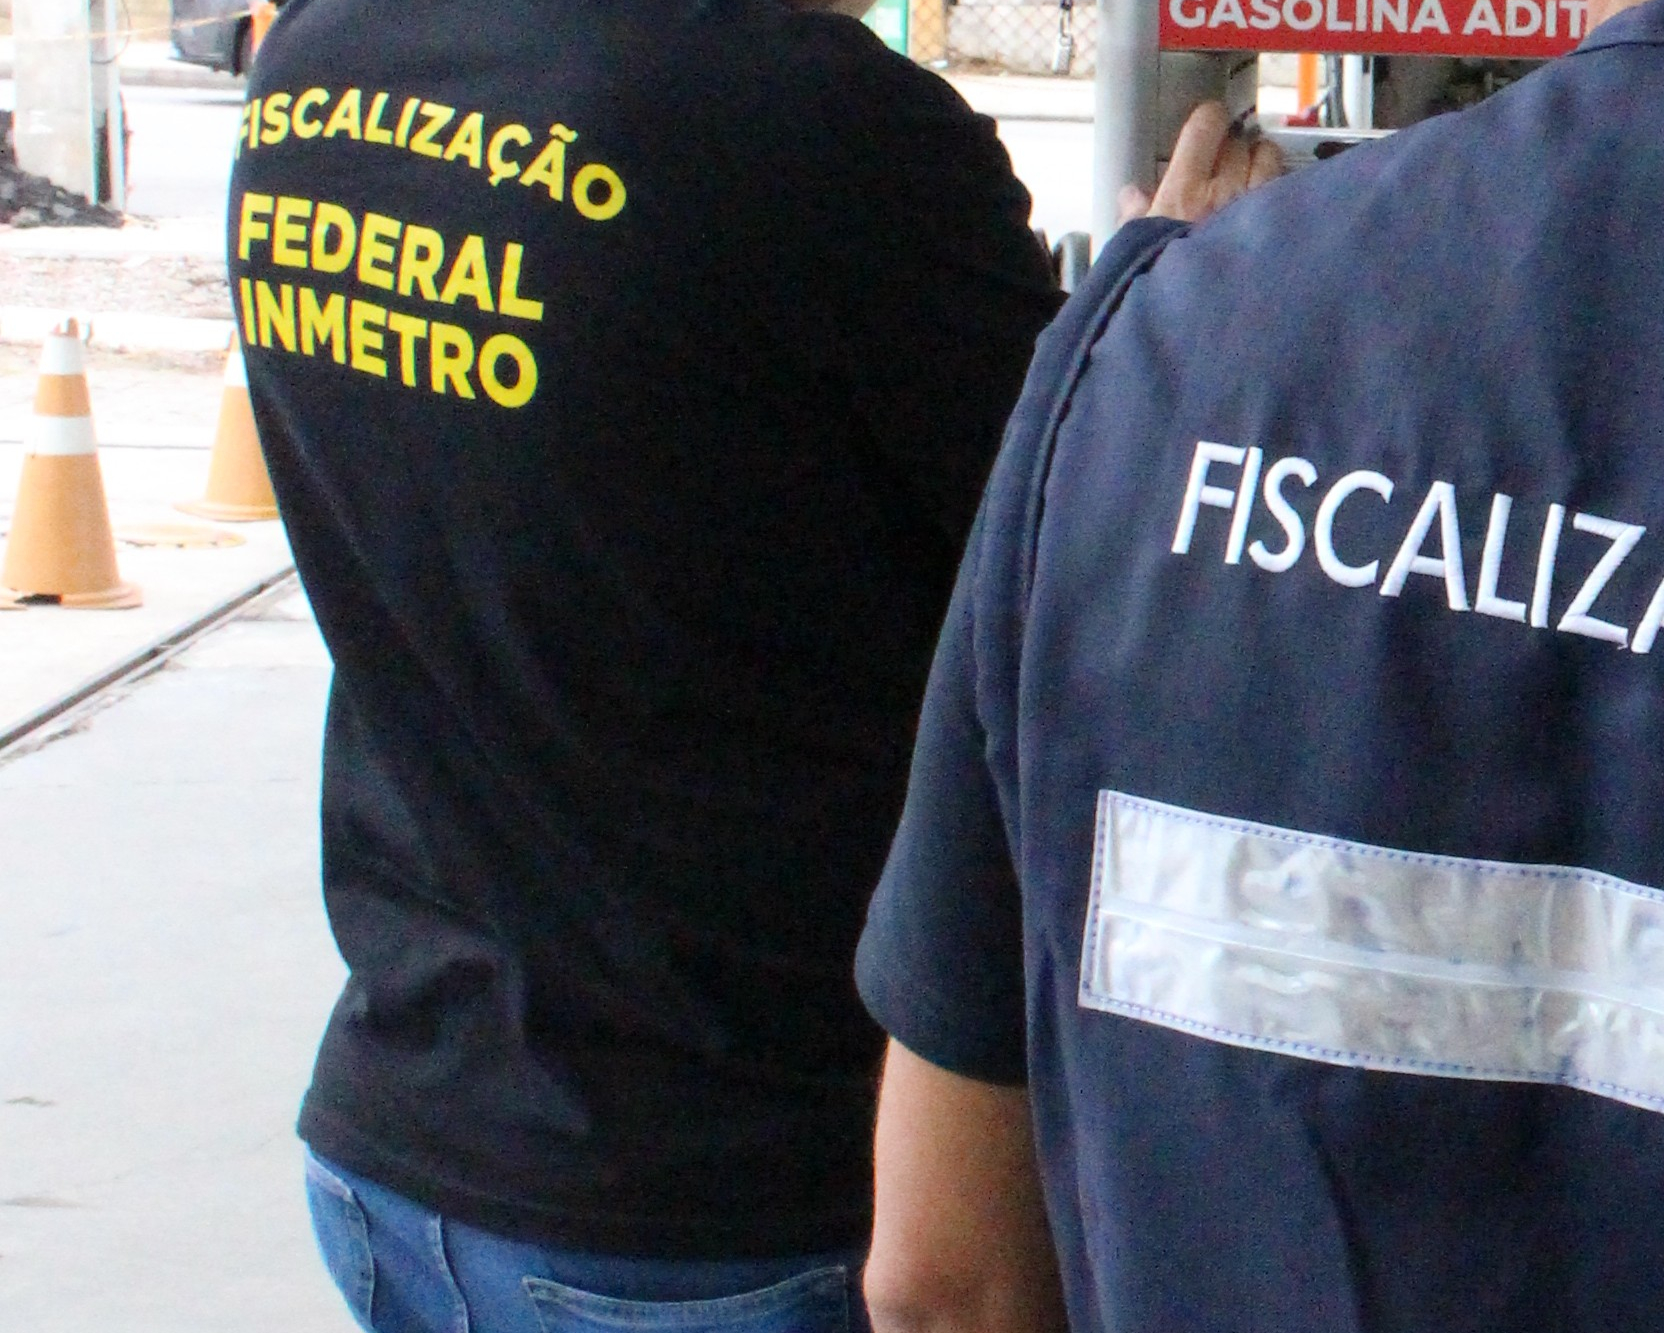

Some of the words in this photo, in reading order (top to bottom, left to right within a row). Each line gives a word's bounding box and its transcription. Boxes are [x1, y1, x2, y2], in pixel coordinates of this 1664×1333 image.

[235, 87, 627, 221] FISCALIZAÇÃO
[237, 191, 545, 321] FEDERAL
[238, 277, 539, 409] INMETRO
